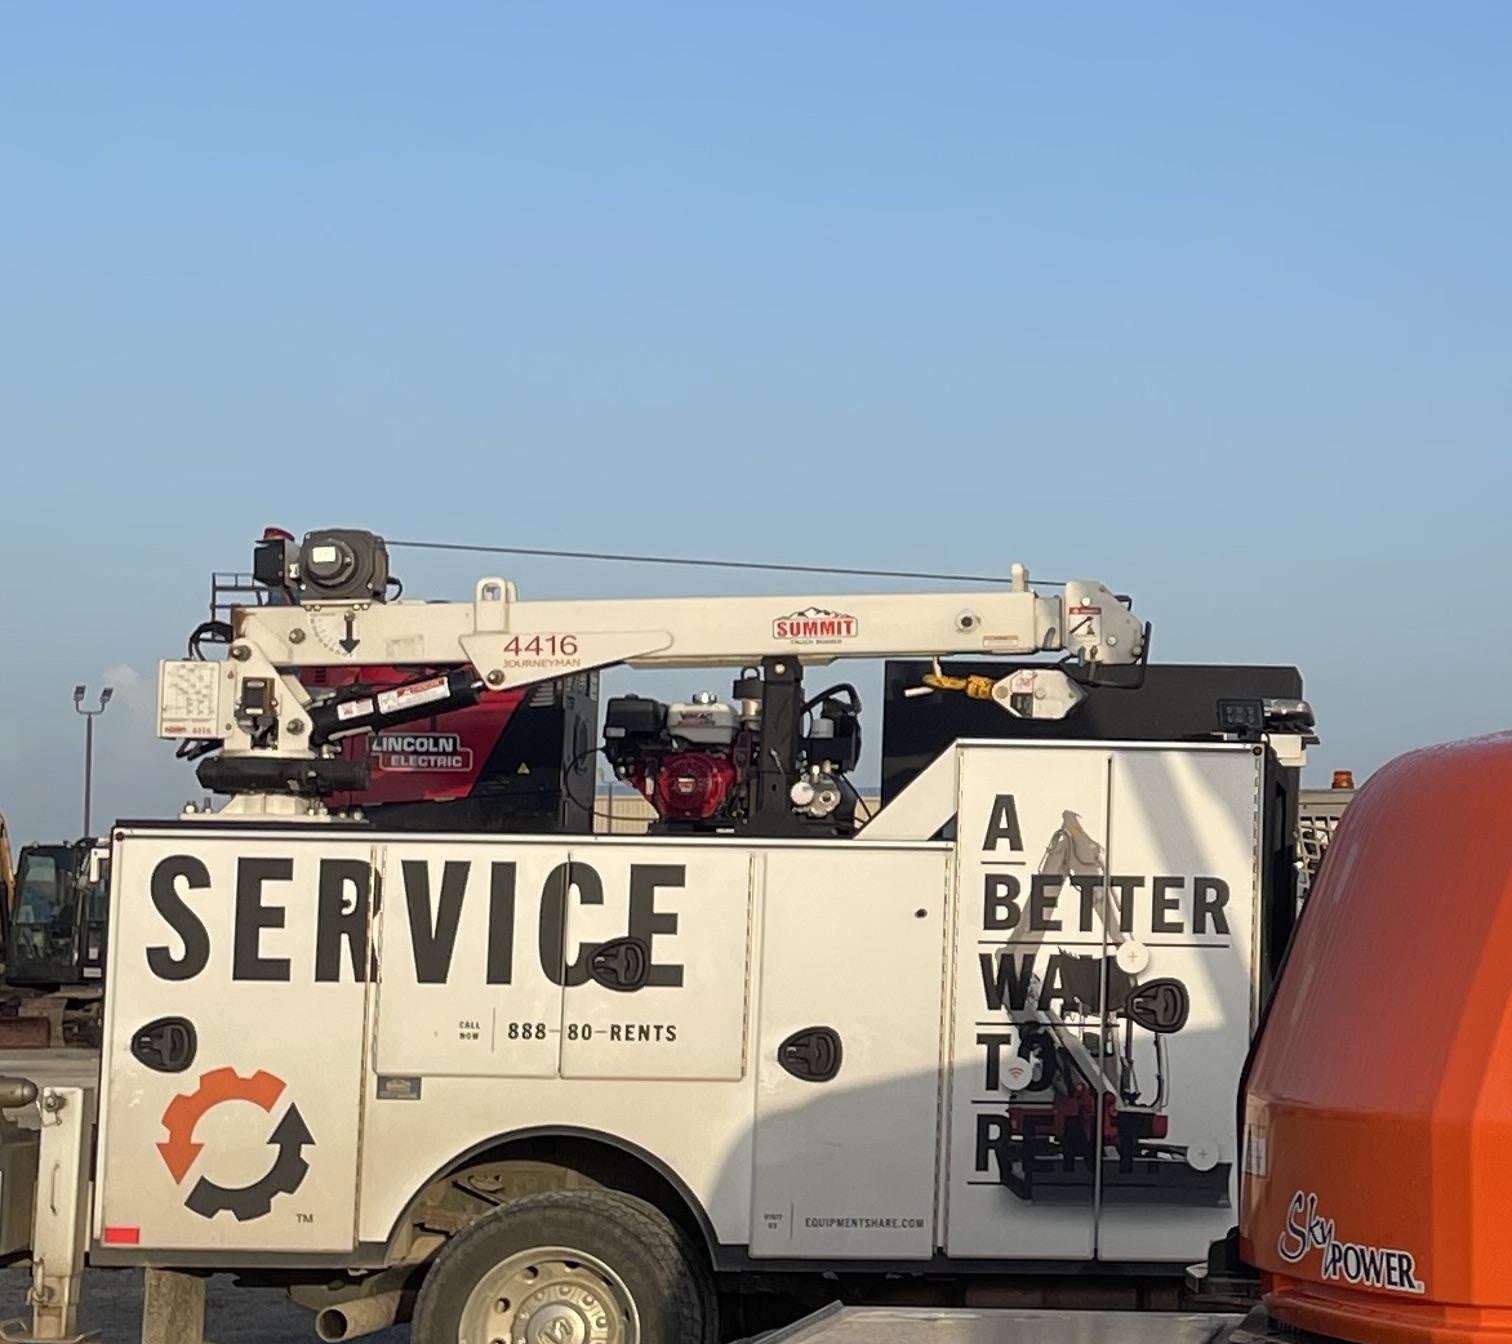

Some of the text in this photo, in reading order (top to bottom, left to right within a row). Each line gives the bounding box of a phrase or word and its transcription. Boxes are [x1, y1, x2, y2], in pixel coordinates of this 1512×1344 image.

[776, 619, 854, 637] SUMMIT
[503, 635, 578, 656] 4416
[503, 658, 580, 669] JOURNEYMAN
[372, 737, 454, 753] LINCOLN
[390, 754, 463, 767] ELECTRIC
[982, 793, 1024, 852] A
[982, 872, 1232, 936] BETTER
[145, 854, 687, 988] SERVICE
[458, 1020, 481, 1030] CALL
[805, 1217, 925, 1229] EQUIPMENTSHARE.COM
[1330, 1243, 1416, 1290] POWER
